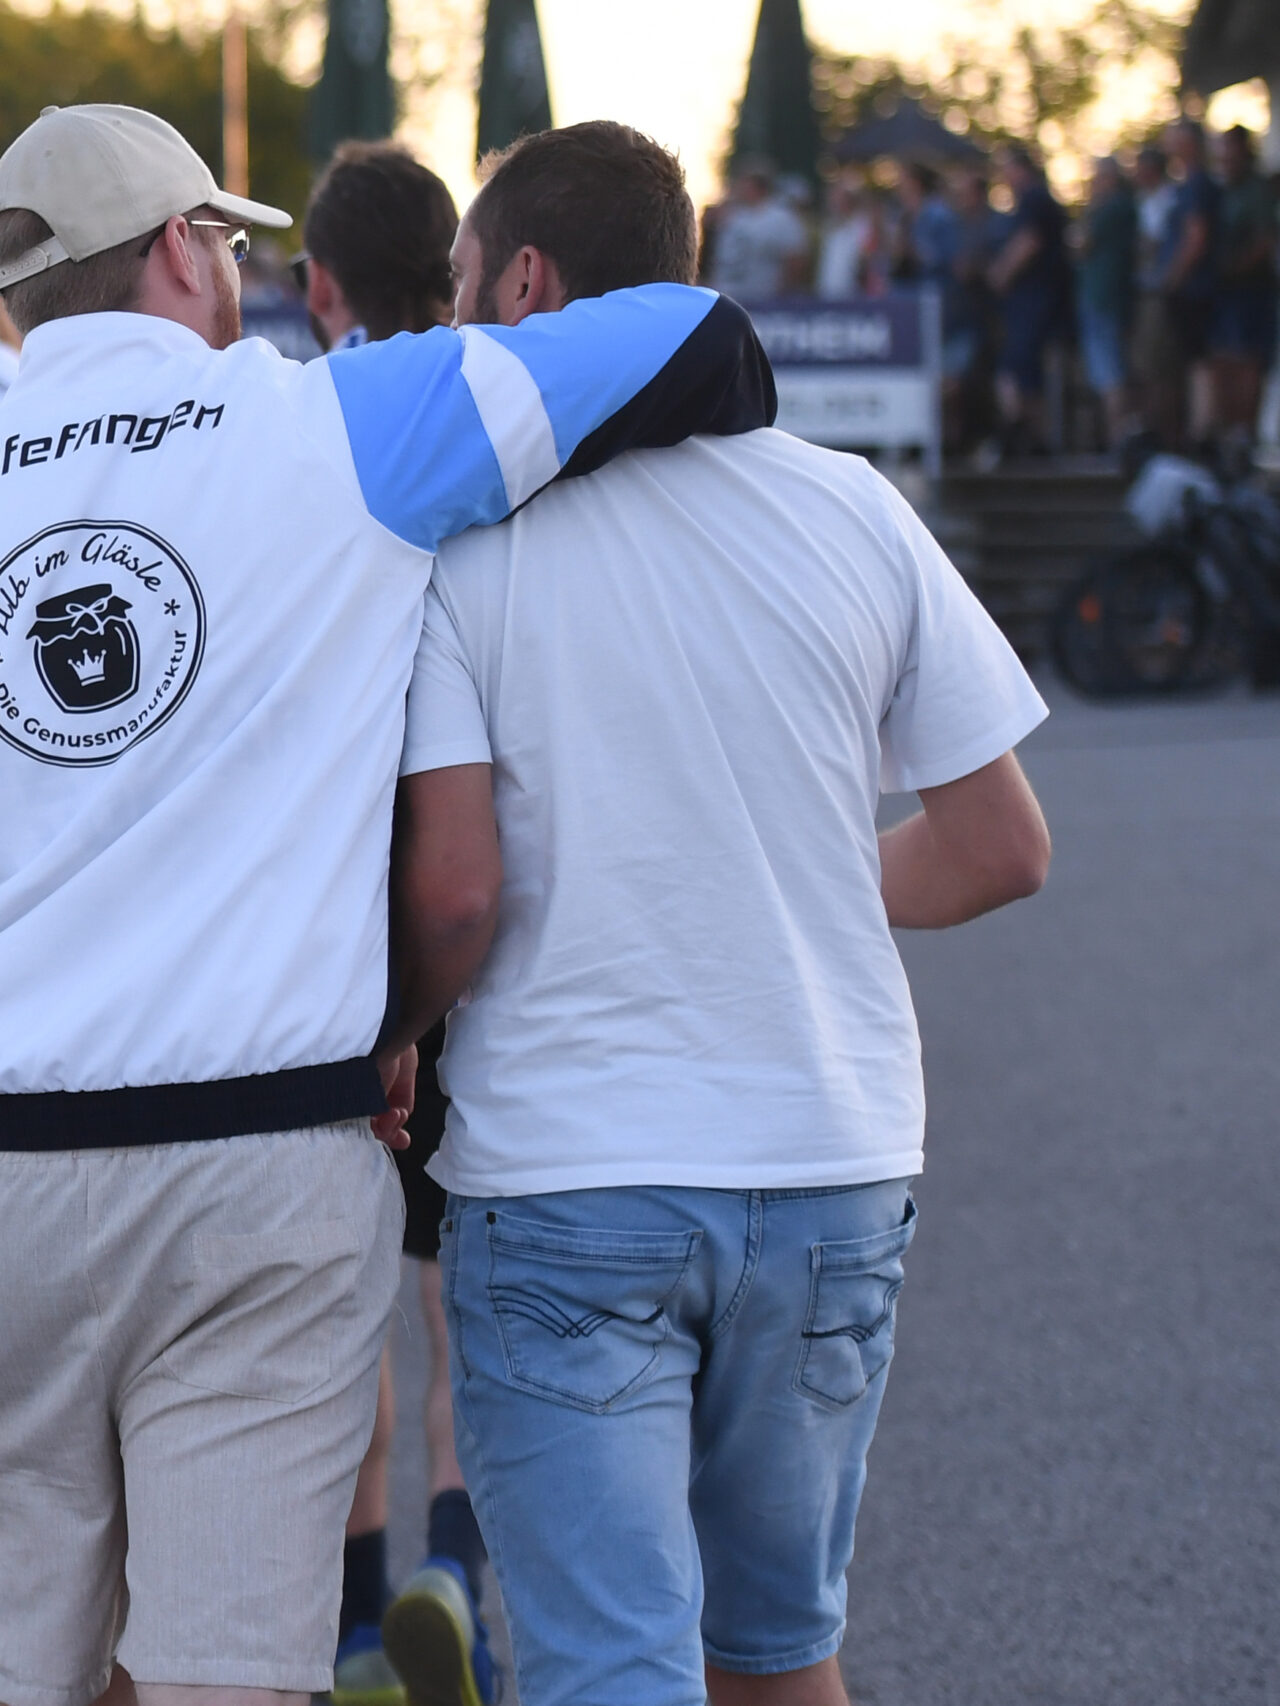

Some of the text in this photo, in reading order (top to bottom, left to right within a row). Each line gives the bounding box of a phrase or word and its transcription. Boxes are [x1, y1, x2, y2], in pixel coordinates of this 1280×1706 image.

[34, 549, 69, 578] im
[80, 532, 164, 592] Gläsle
[23, 629, 188, 748] Genussmanufaktur
